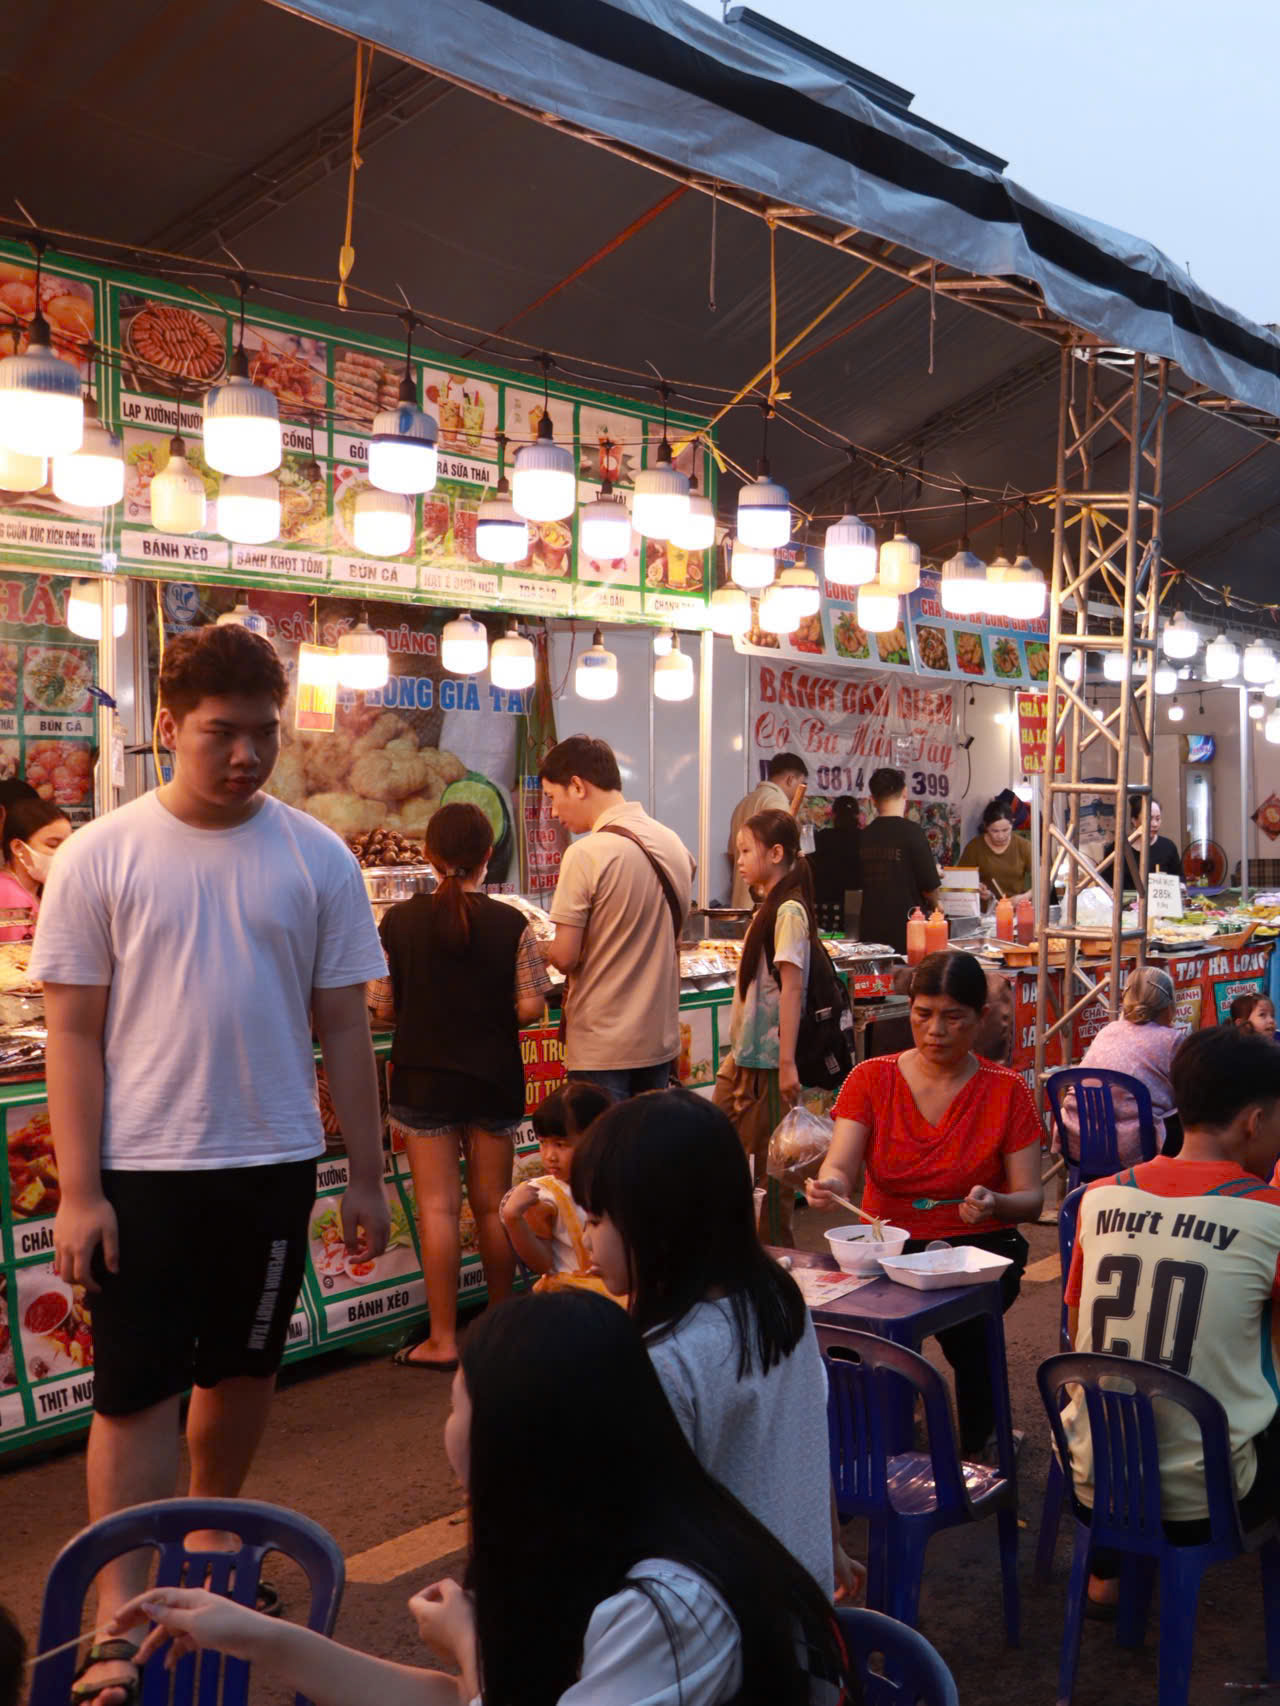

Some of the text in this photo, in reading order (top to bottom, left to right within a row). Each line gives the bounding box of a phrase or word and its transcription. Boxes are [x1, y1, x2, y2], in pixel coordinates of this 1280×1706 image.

[123, 402, 141, 422] LẠP
[282, 430, 312, 450] CỐNG
[451, 462, 469, 479] SỮA
[470, 466, 490, 482] THÁI
[142, 538, 208, 562] BÁNH XÈO
[270, 556, 297, 573] KHỌT
[381, 566, 399, 582] CÁ
[760, 666, 836, 712] BÁNH
[40, 719, 82, 732] BÚN CÁ
[912, 771, 950, 798] 399
[1176, 960, 1204, 981] TAY
[318, 1165, 348, 1188] XƯỞNG
[1096, 1207, 1240, 1251] Nhựt Huy
[348, 1289, 410, 1322] BÁNH XÈO
[1091, 1253, 1209, 1377] 20
[38, 1388, 68, 1413] THỊT
